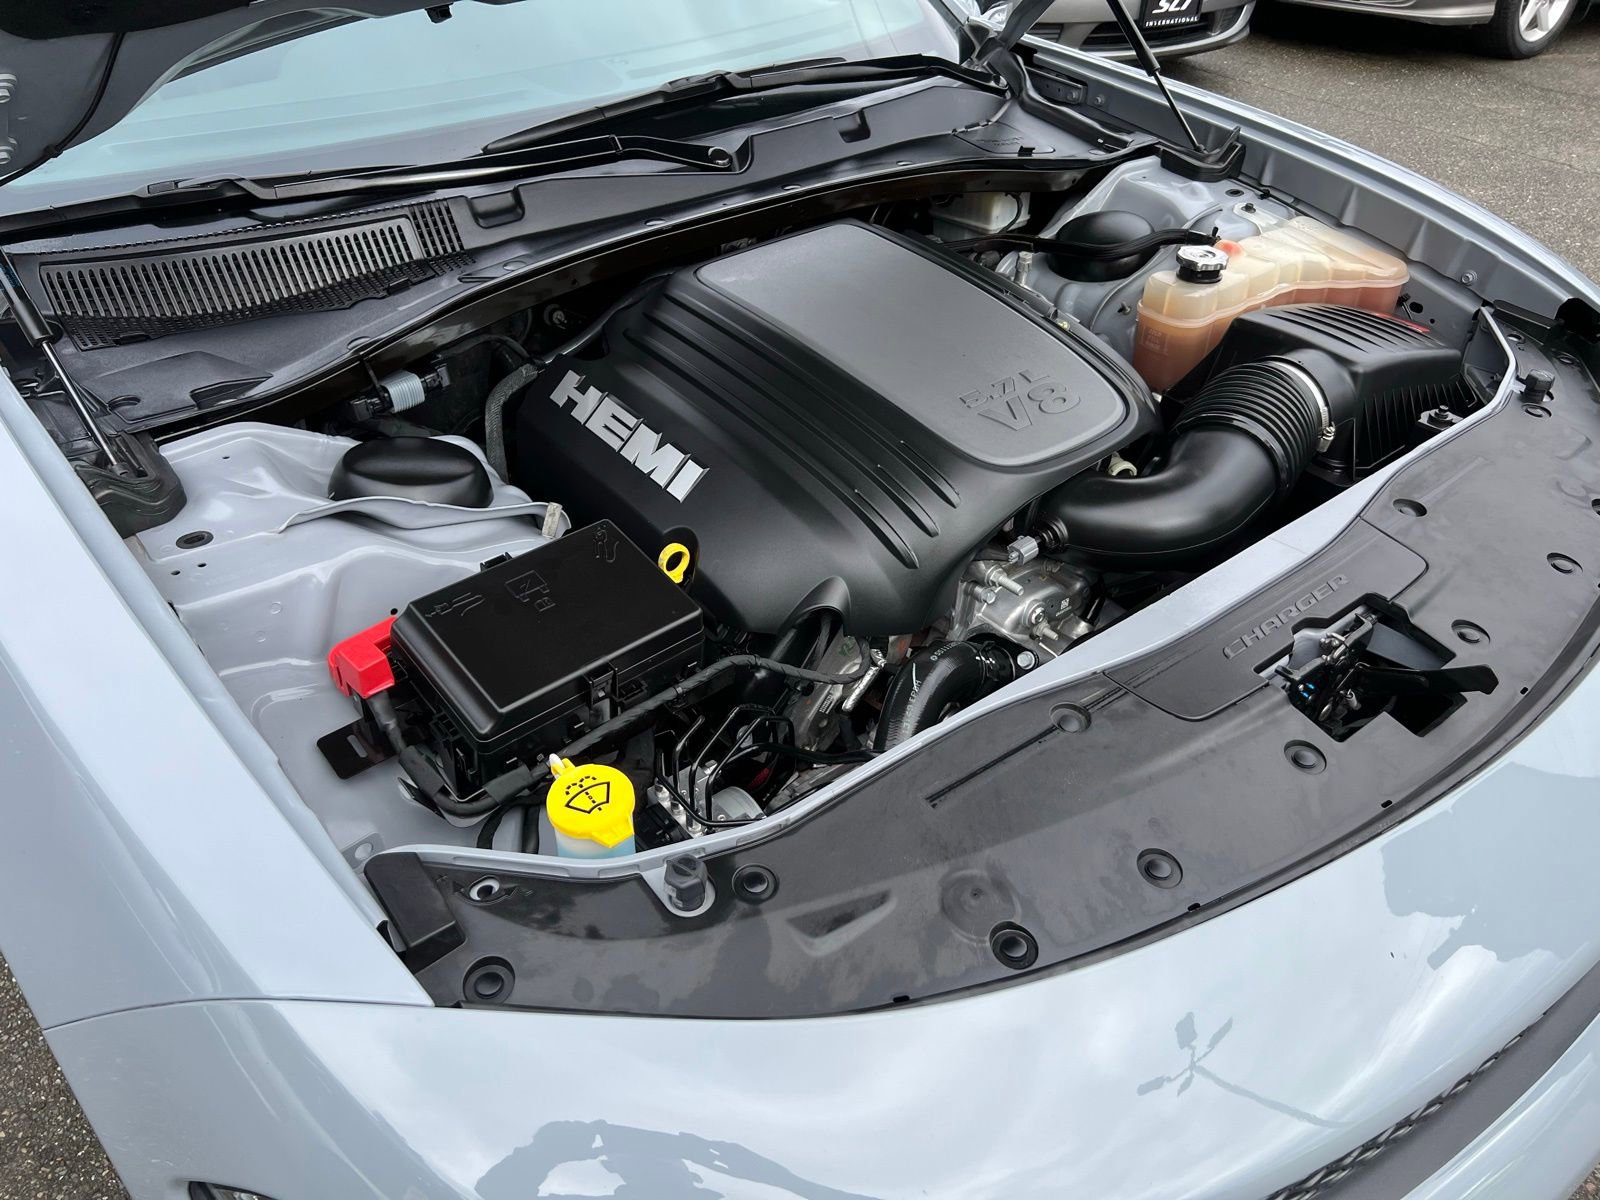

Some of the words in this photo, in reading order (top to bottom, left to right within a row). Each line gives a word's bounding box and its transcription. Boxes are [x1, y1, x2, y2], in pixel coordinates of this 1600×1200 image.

[1145, 16, 1199, 27] INTERNATIONAL
[959, 369, 1051, 409] 5.7L
[977, 381, 1082, 431] V8
[549, 369, 711, 503] HEMI
[1222, 573, 1350, 660] CHARGER
